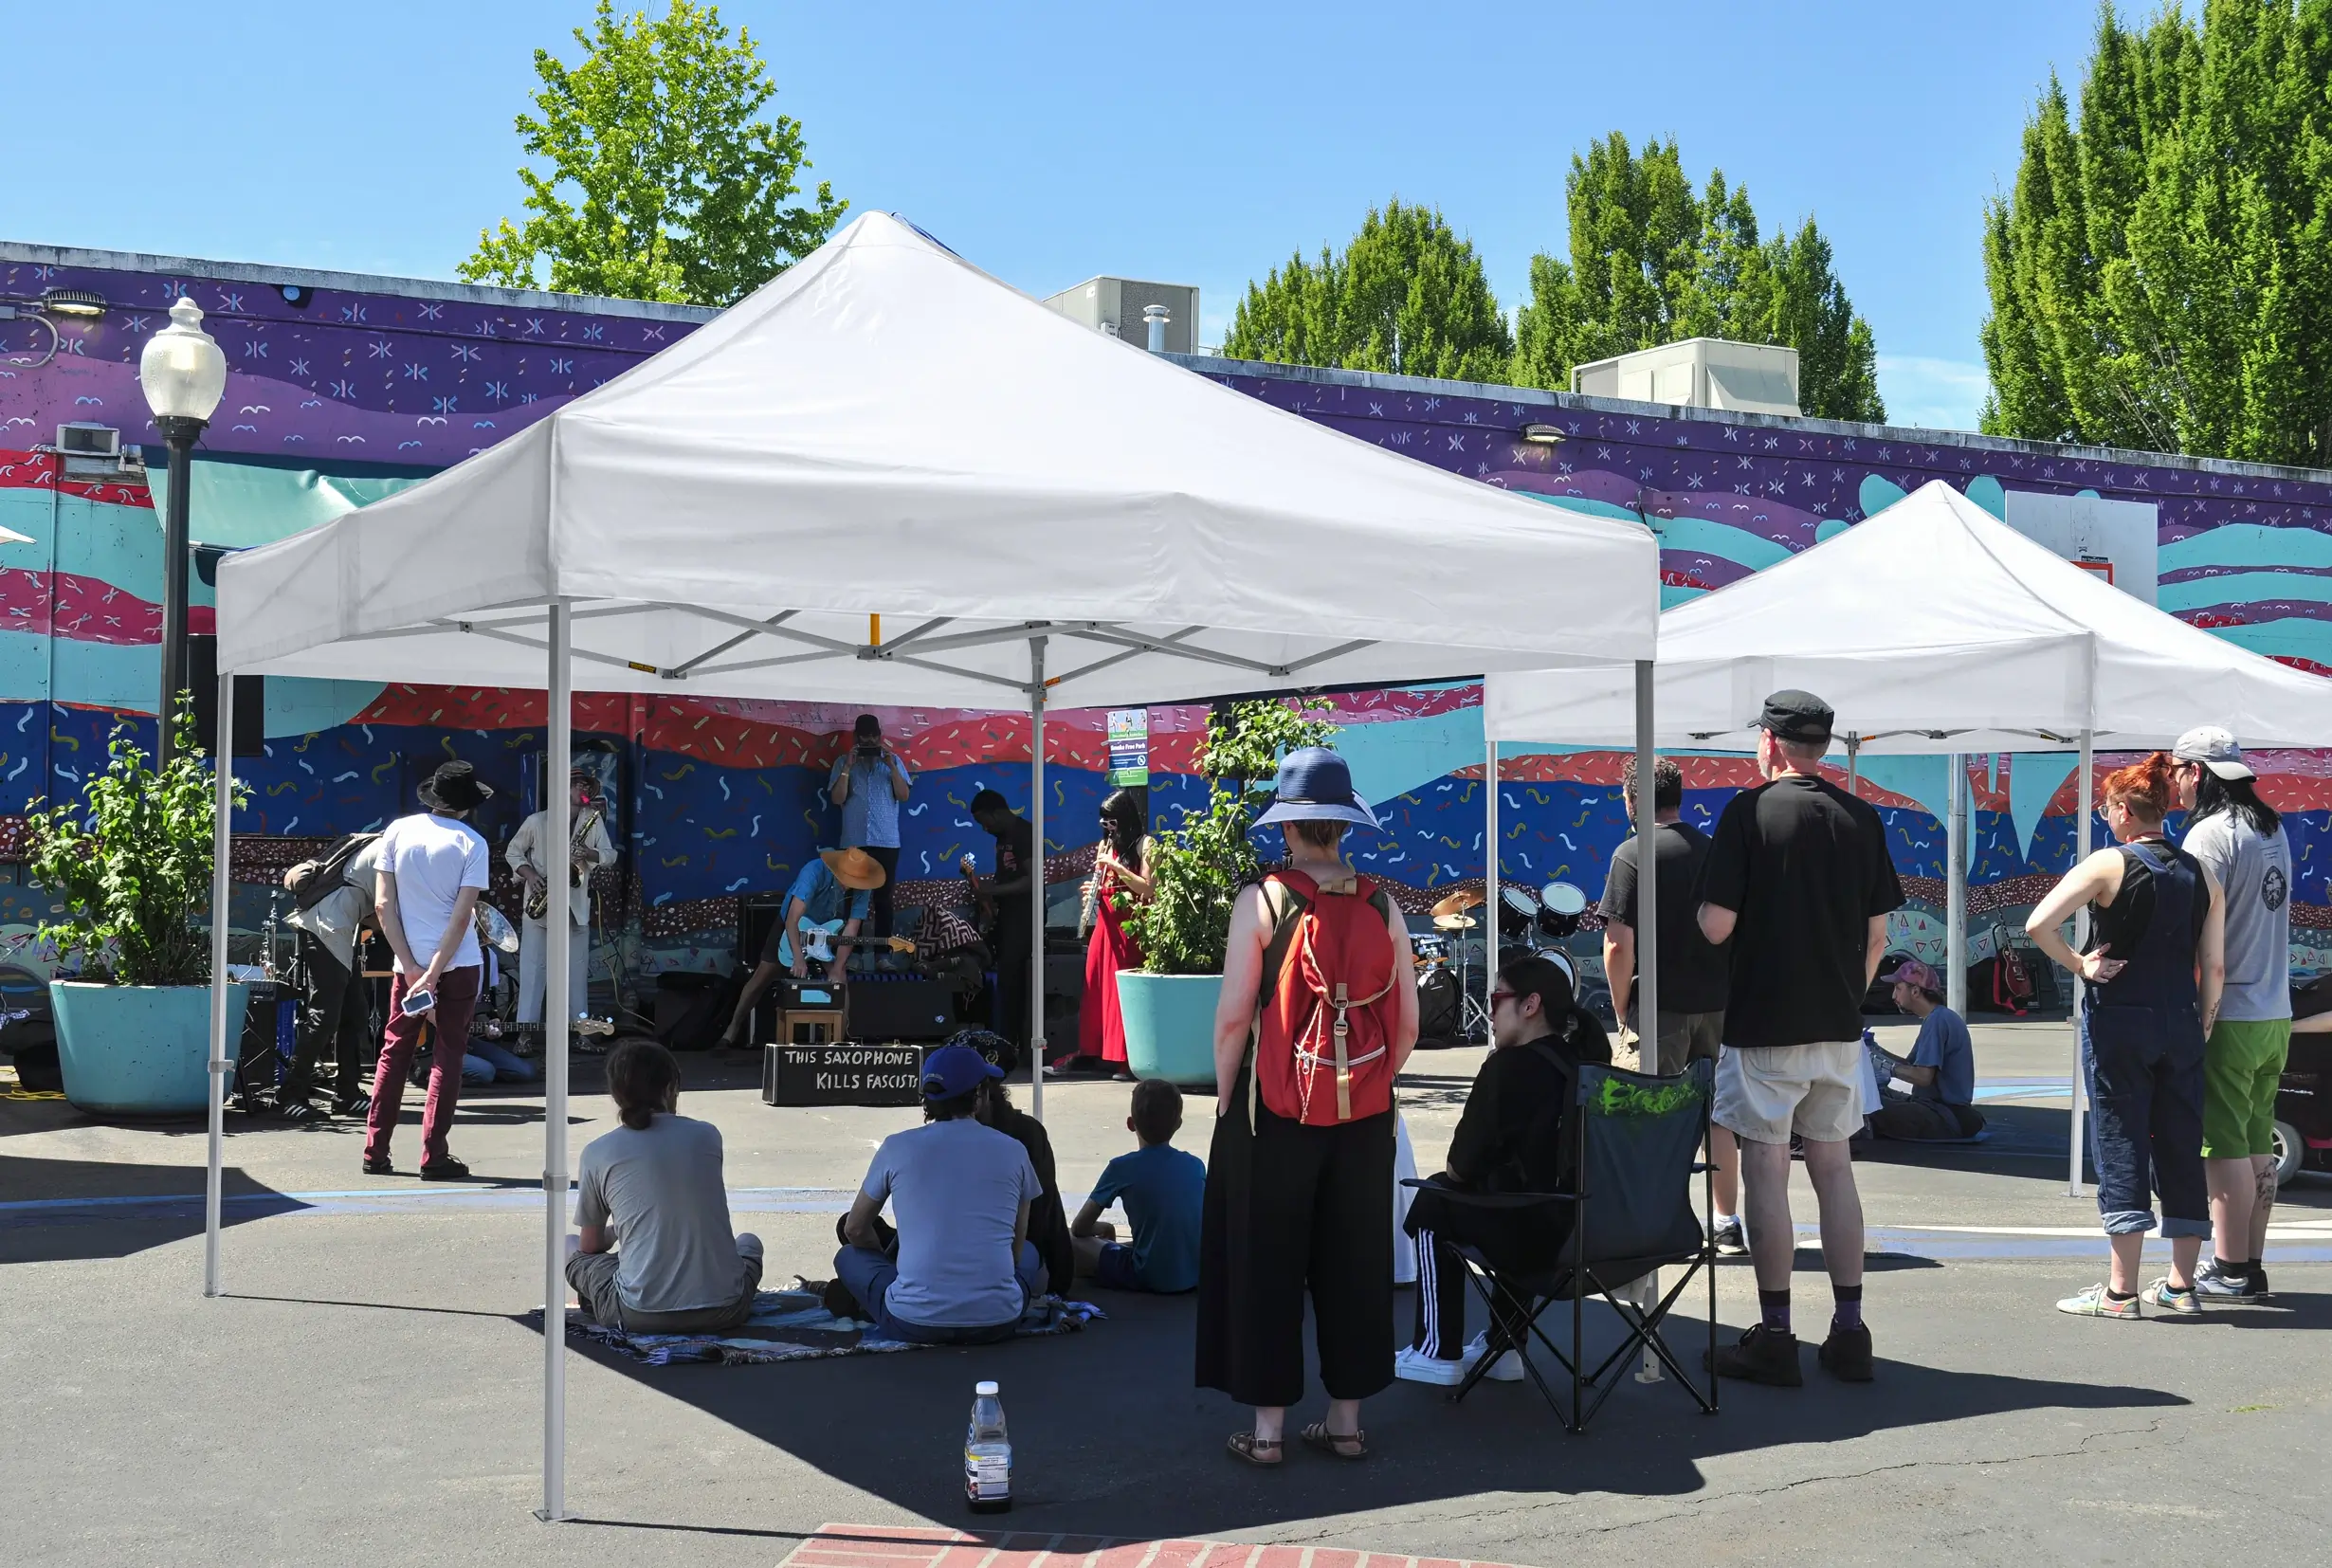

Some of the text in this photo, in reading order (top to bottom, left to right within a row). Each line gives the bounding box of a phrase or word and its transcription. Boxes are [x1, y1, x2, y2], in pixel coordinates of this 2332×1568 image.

[785, 1050, 913, 1065] THIS SAXOPHONE
[816, 1071, 860, 1089] KILLS
